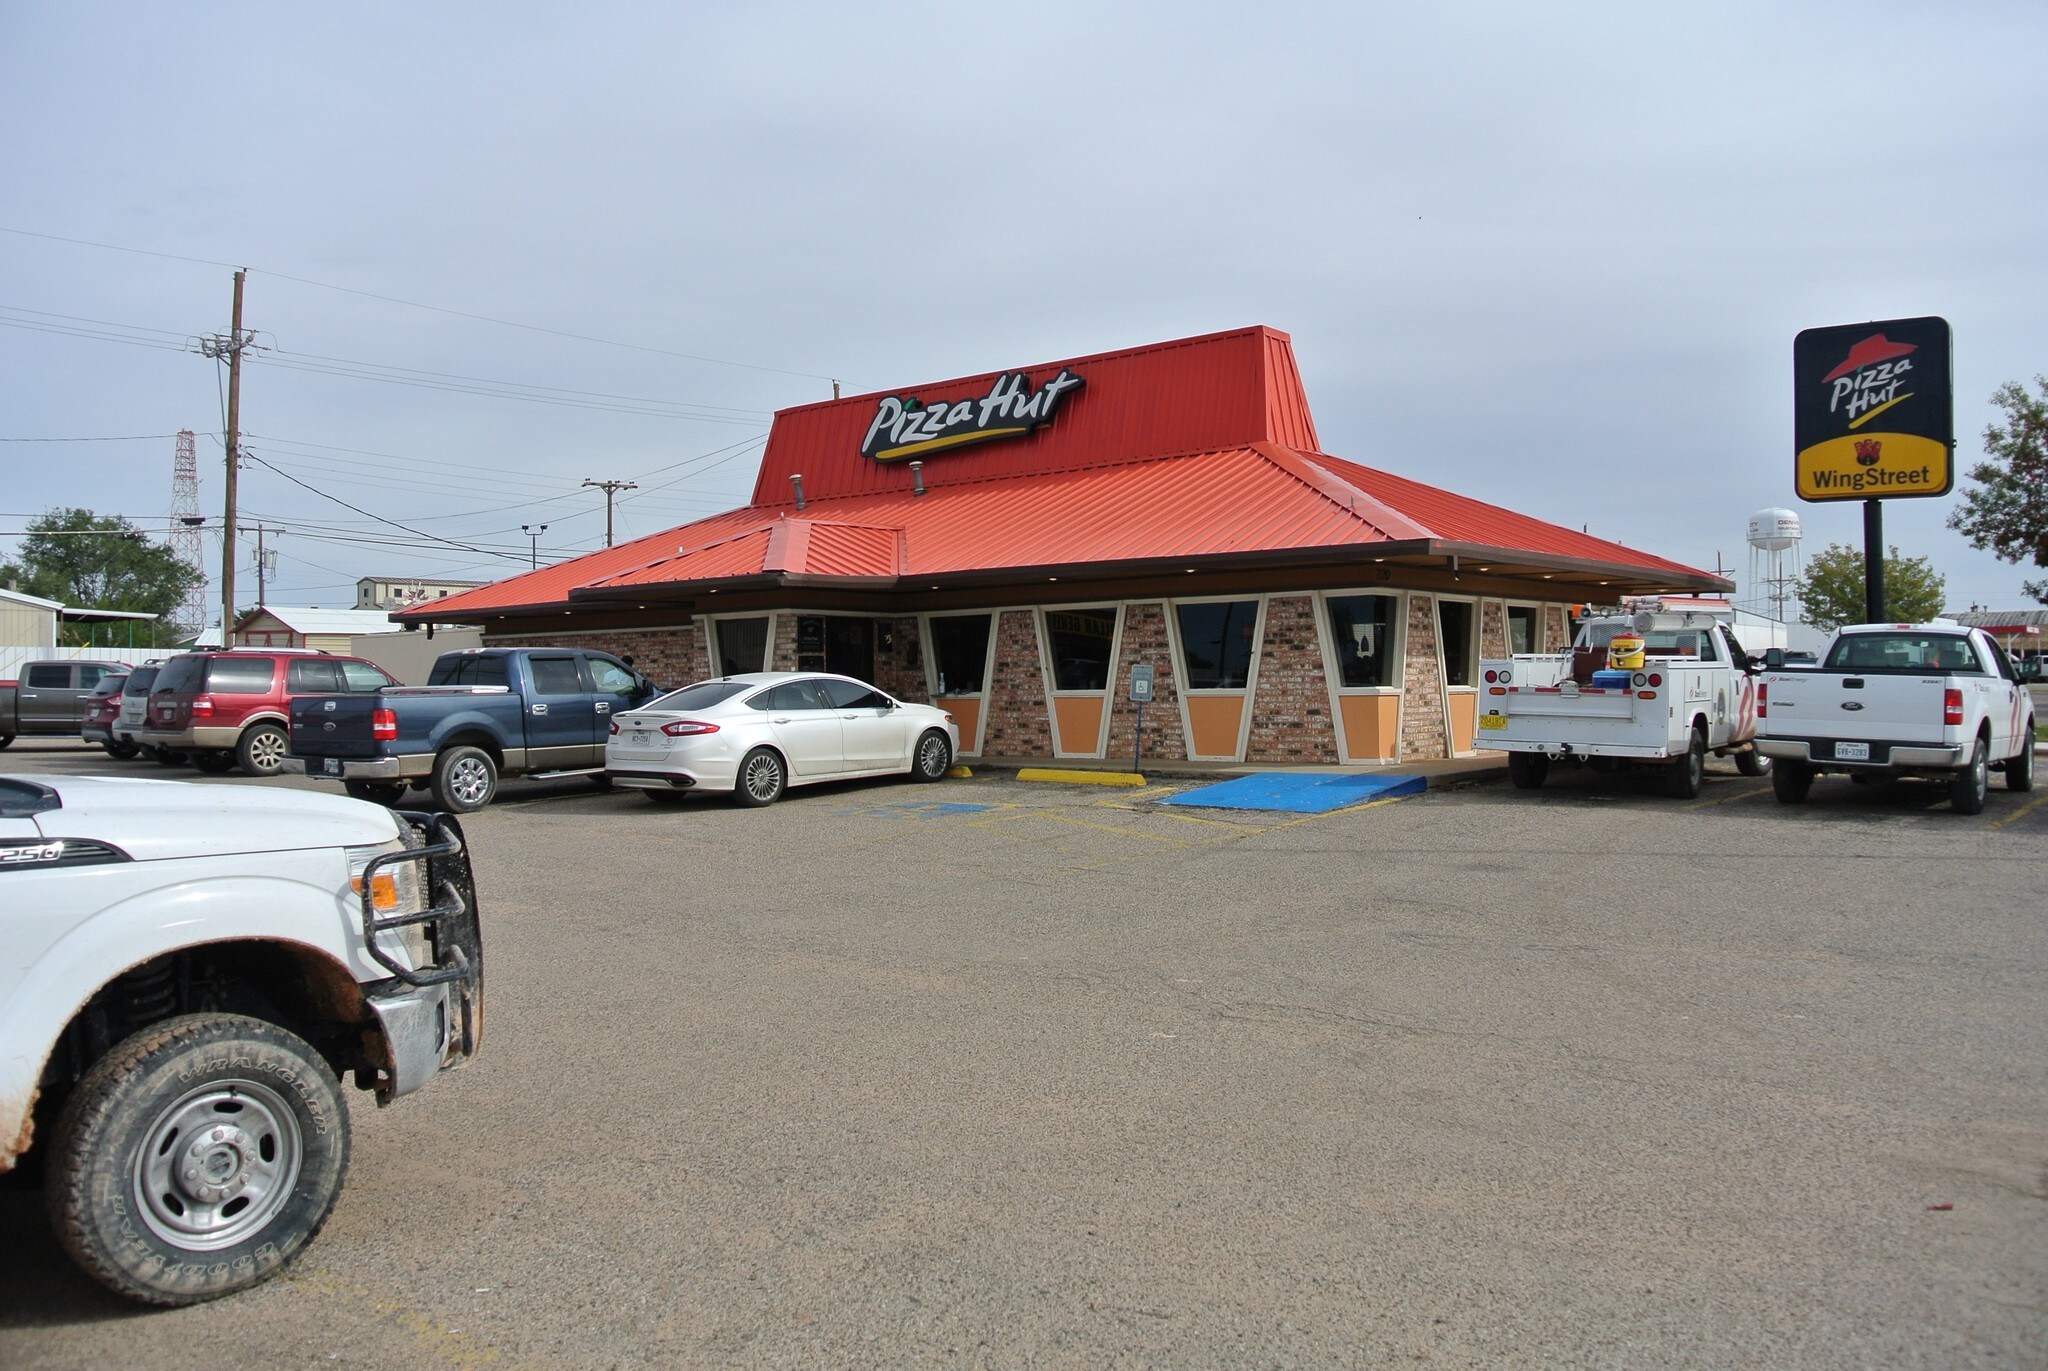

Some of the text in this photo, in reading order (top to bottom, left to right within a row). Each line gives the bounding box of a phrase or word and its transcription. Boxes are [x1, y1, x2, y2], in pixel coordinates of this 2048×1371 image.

[861, 371, 1079, 453] Pizza Hut
[1829, 359, 1914, 413] Pizza
[1845, 379, 1906, 419] Hut
[1812, 466, 1931, 490] WingStreet
[178, 1056, 328, 1136] WRANGLER
[112, 1194, 275, 1277] GOODYEAR
